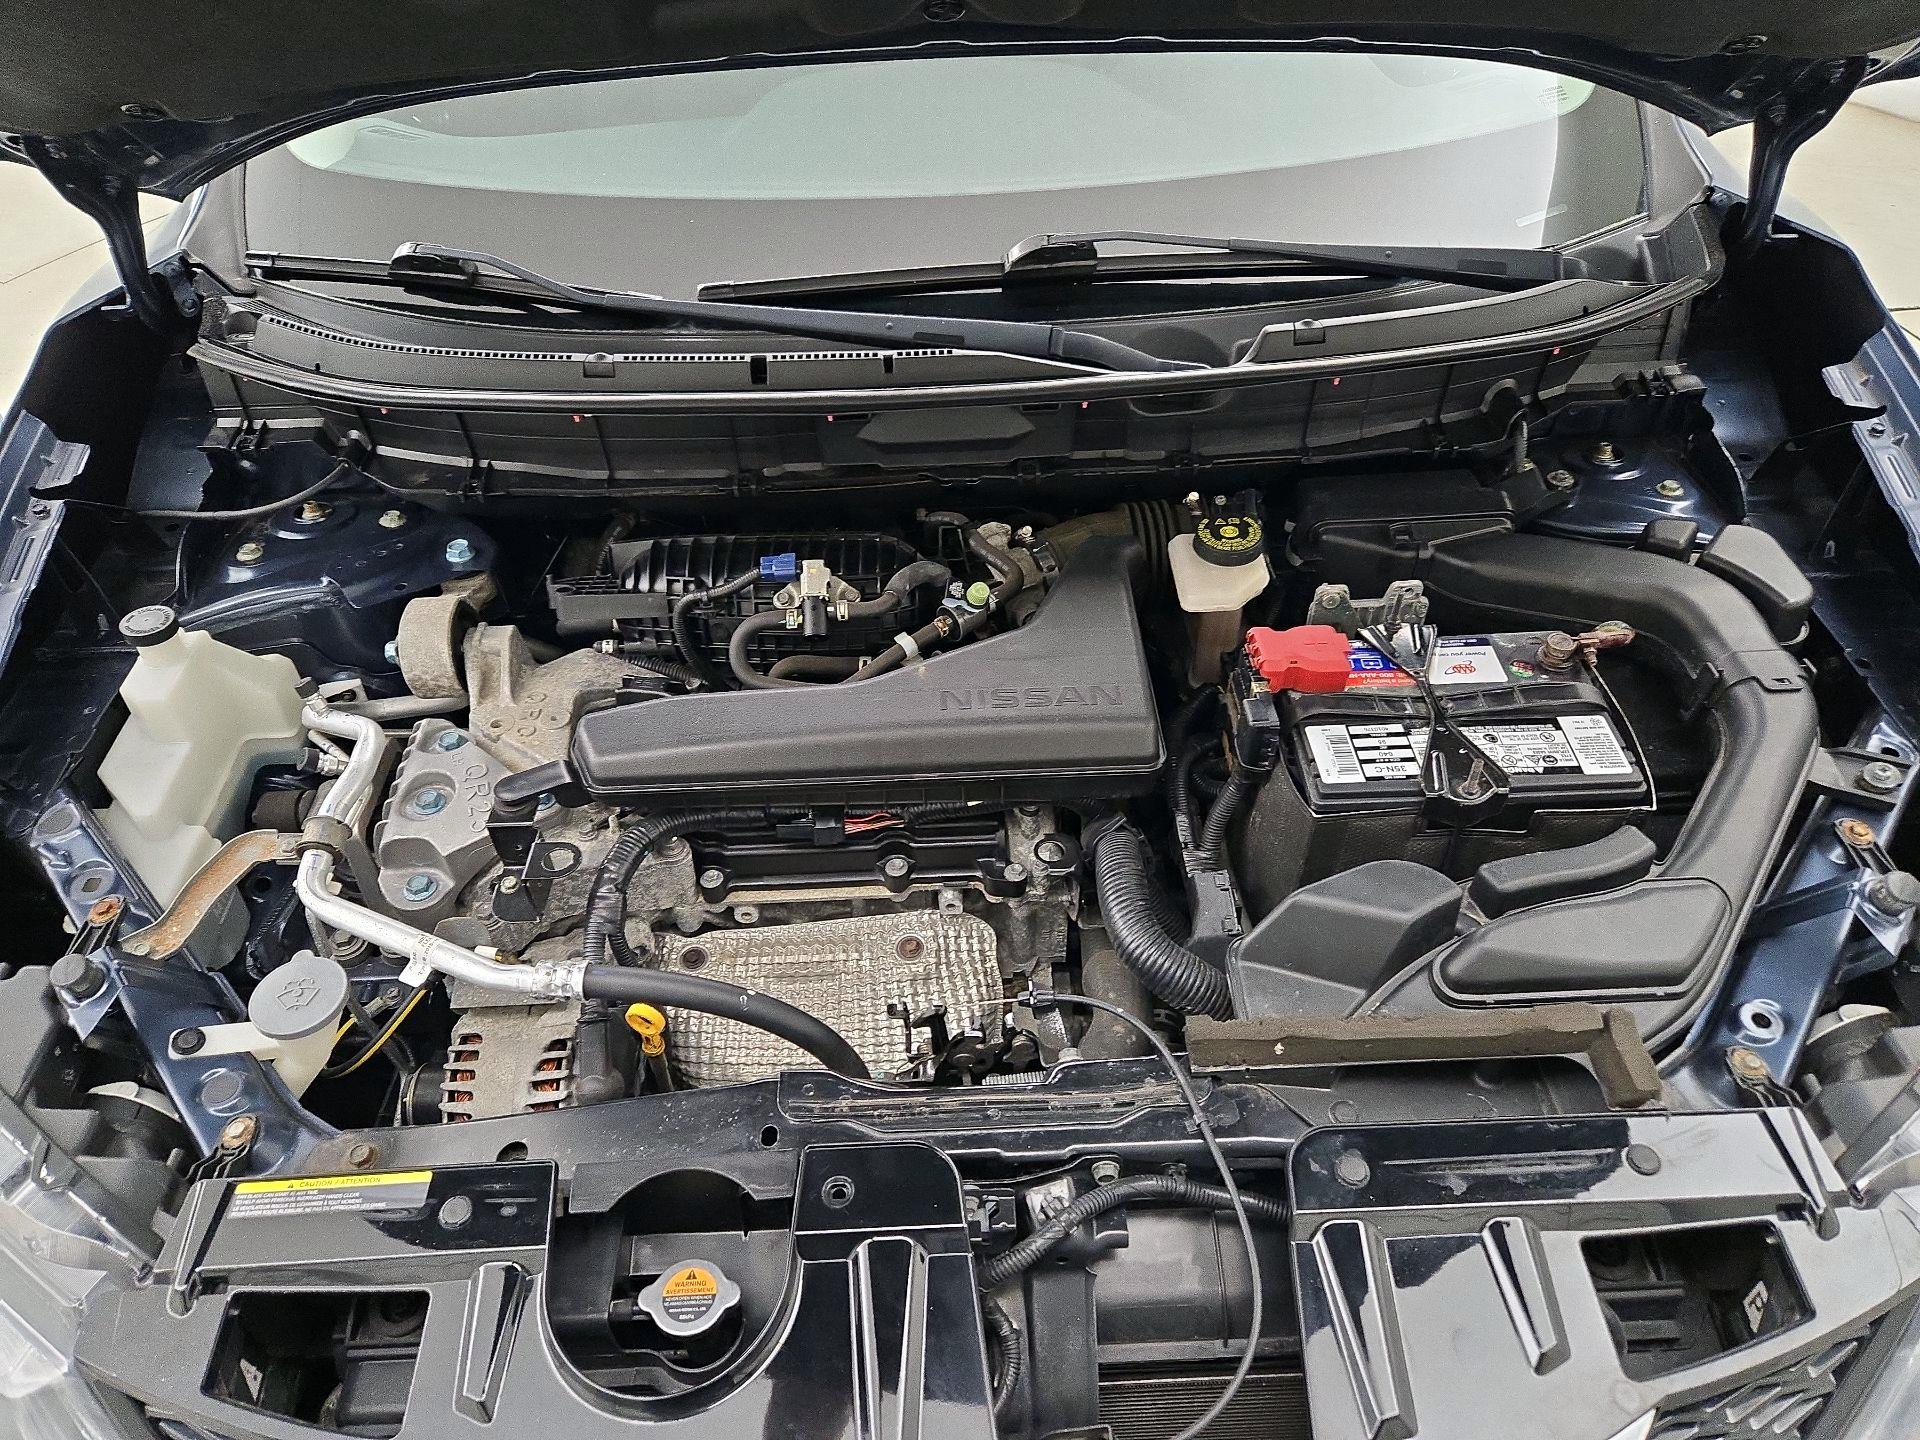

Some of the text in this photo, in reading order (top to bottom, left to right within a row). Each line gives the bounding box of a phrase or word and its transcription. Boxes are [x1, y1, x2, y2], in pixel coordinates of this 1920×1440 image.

[939, 685, 1124, 711] NISSAN
[1374, 765, 1407, 773] 35N-C
[299, 1180, 332, 1188] CAUTION
[340, 1177, 381, 1186] ATTENTION
